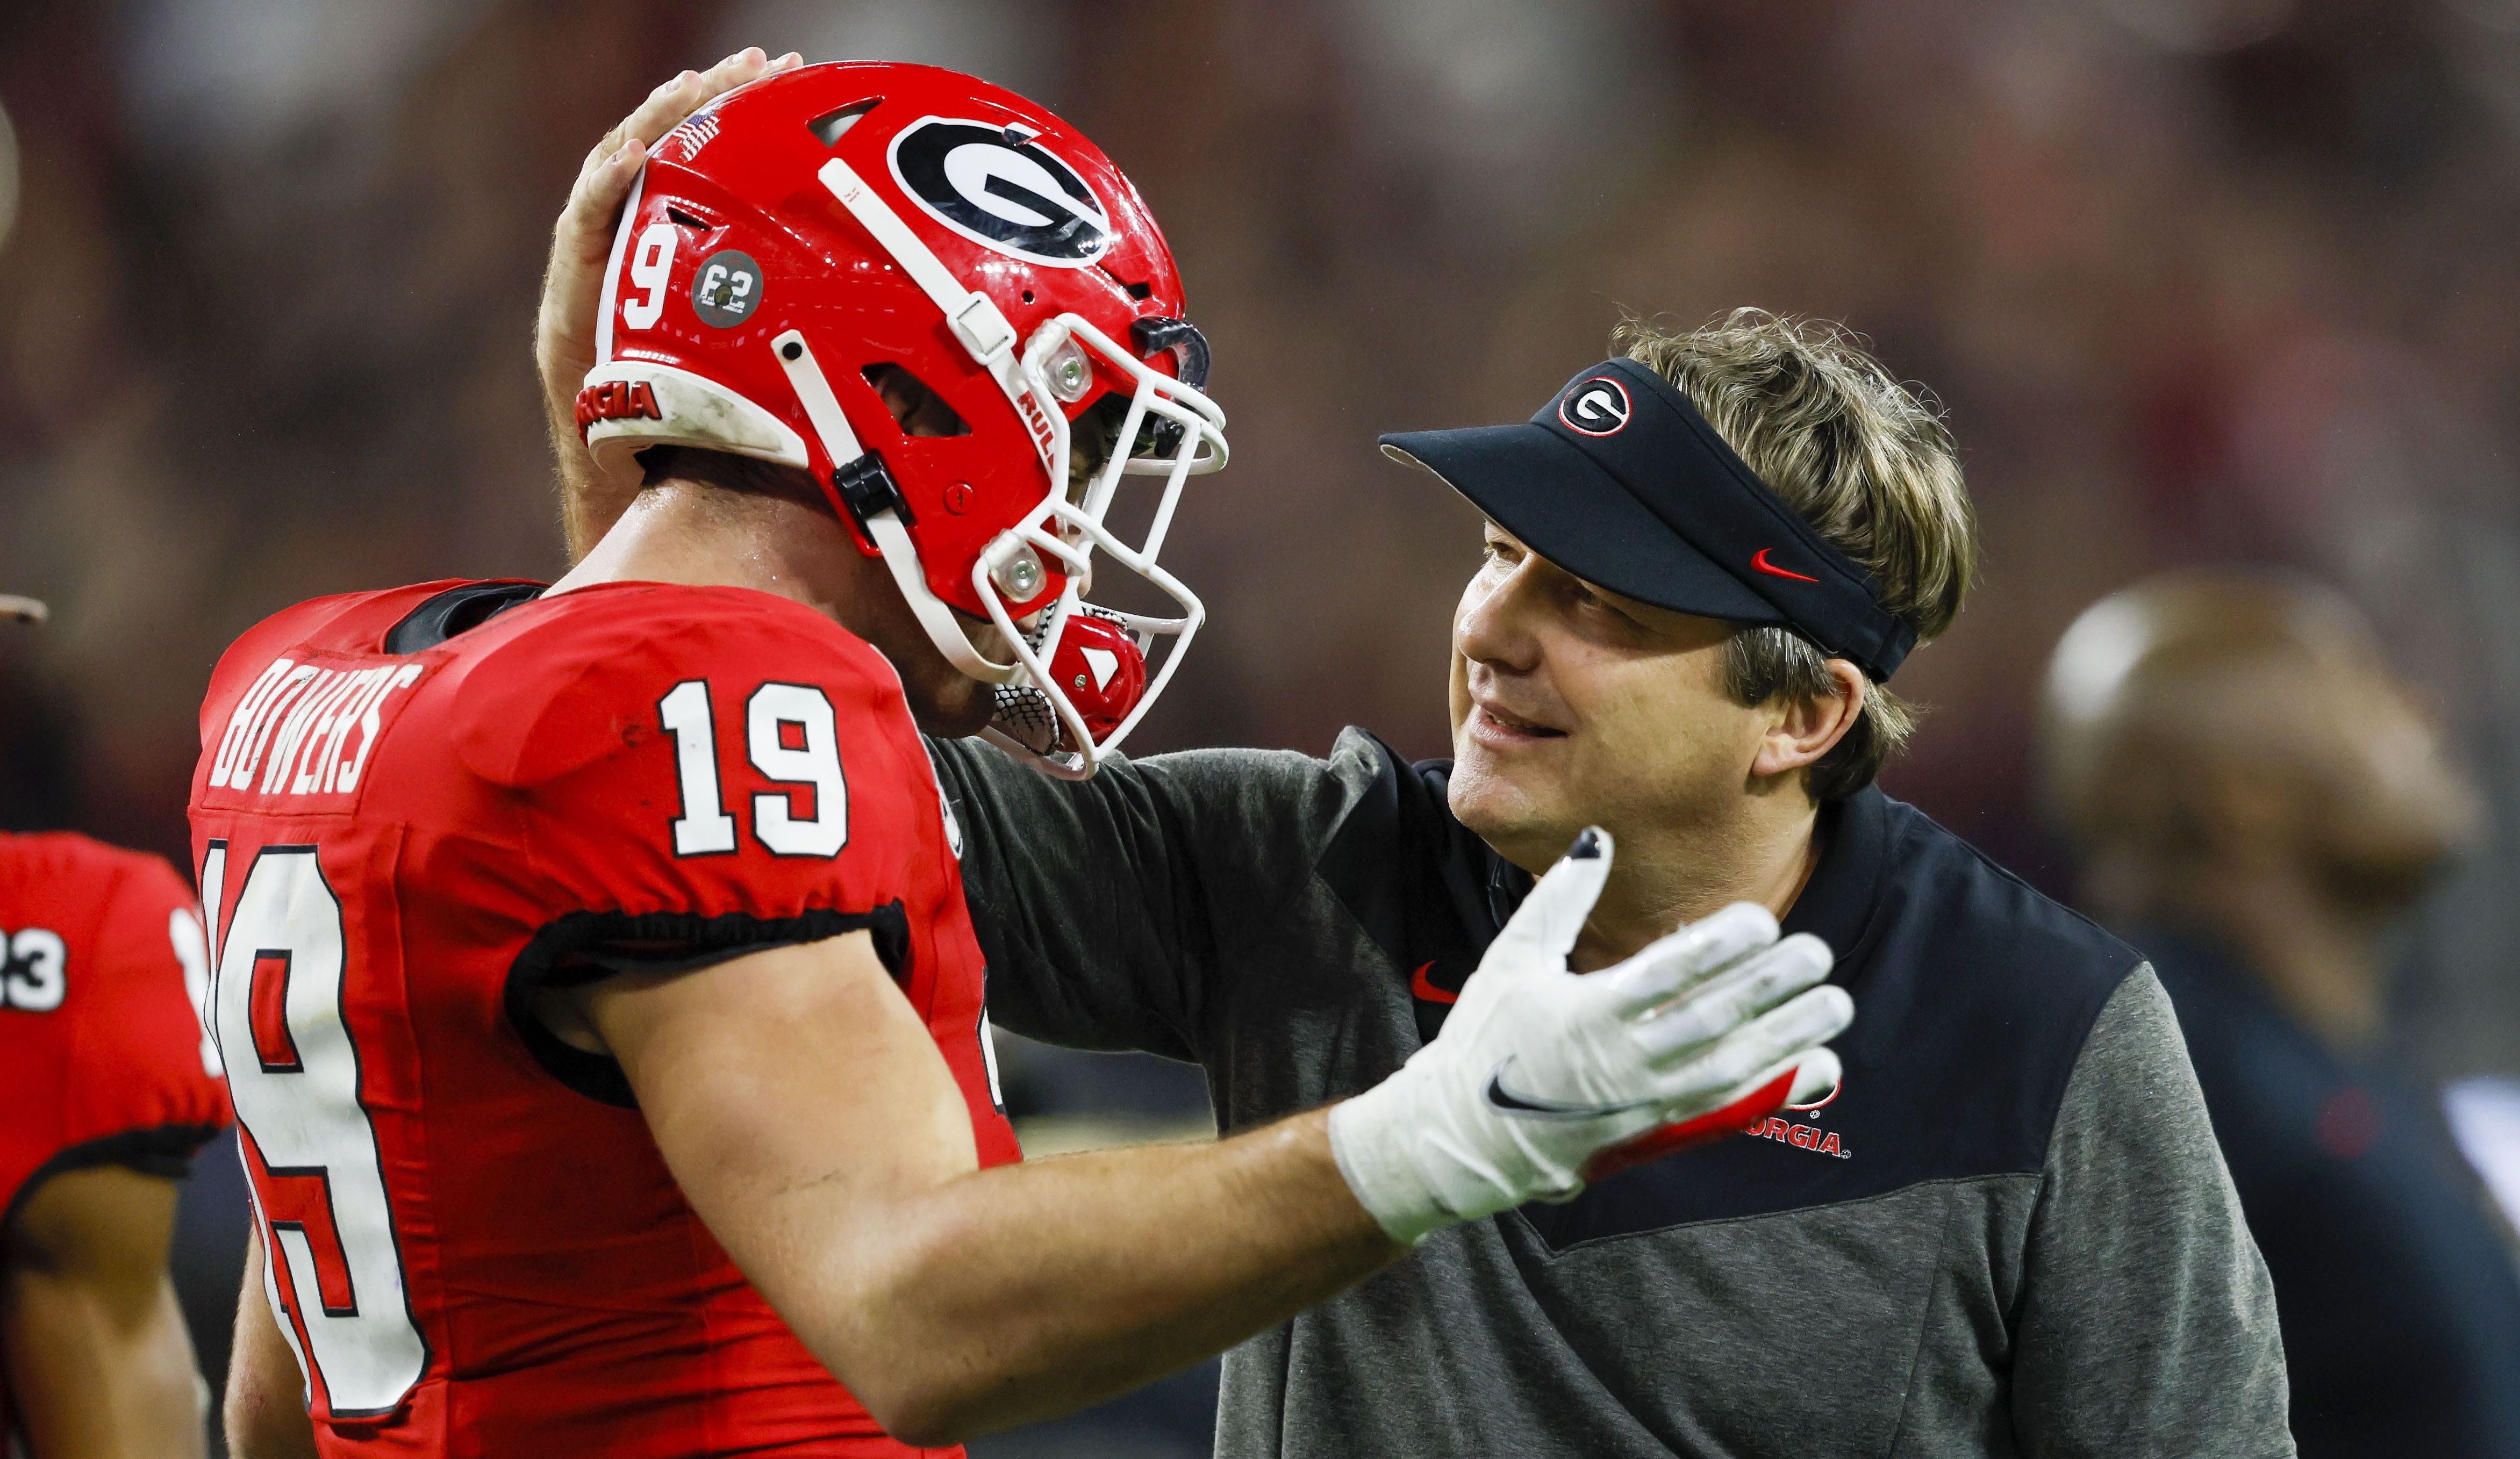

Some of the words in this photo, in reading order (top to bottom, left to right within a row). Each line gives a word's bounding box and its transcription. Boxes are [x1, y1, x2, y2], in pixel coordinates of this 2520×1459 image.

[623, 224, 678, 330] 9
[700, 264, 753, 314] 62
[574, 380, 662, 445] RGIA
[1558, 376, 1633, 437] G
[209, 658, 424, 794] BOWERS
[657, 678, 849, 859] 19
[0, 927, 66, 1011] 3
[1742, 1117, 1841, 1158] ORGIA
